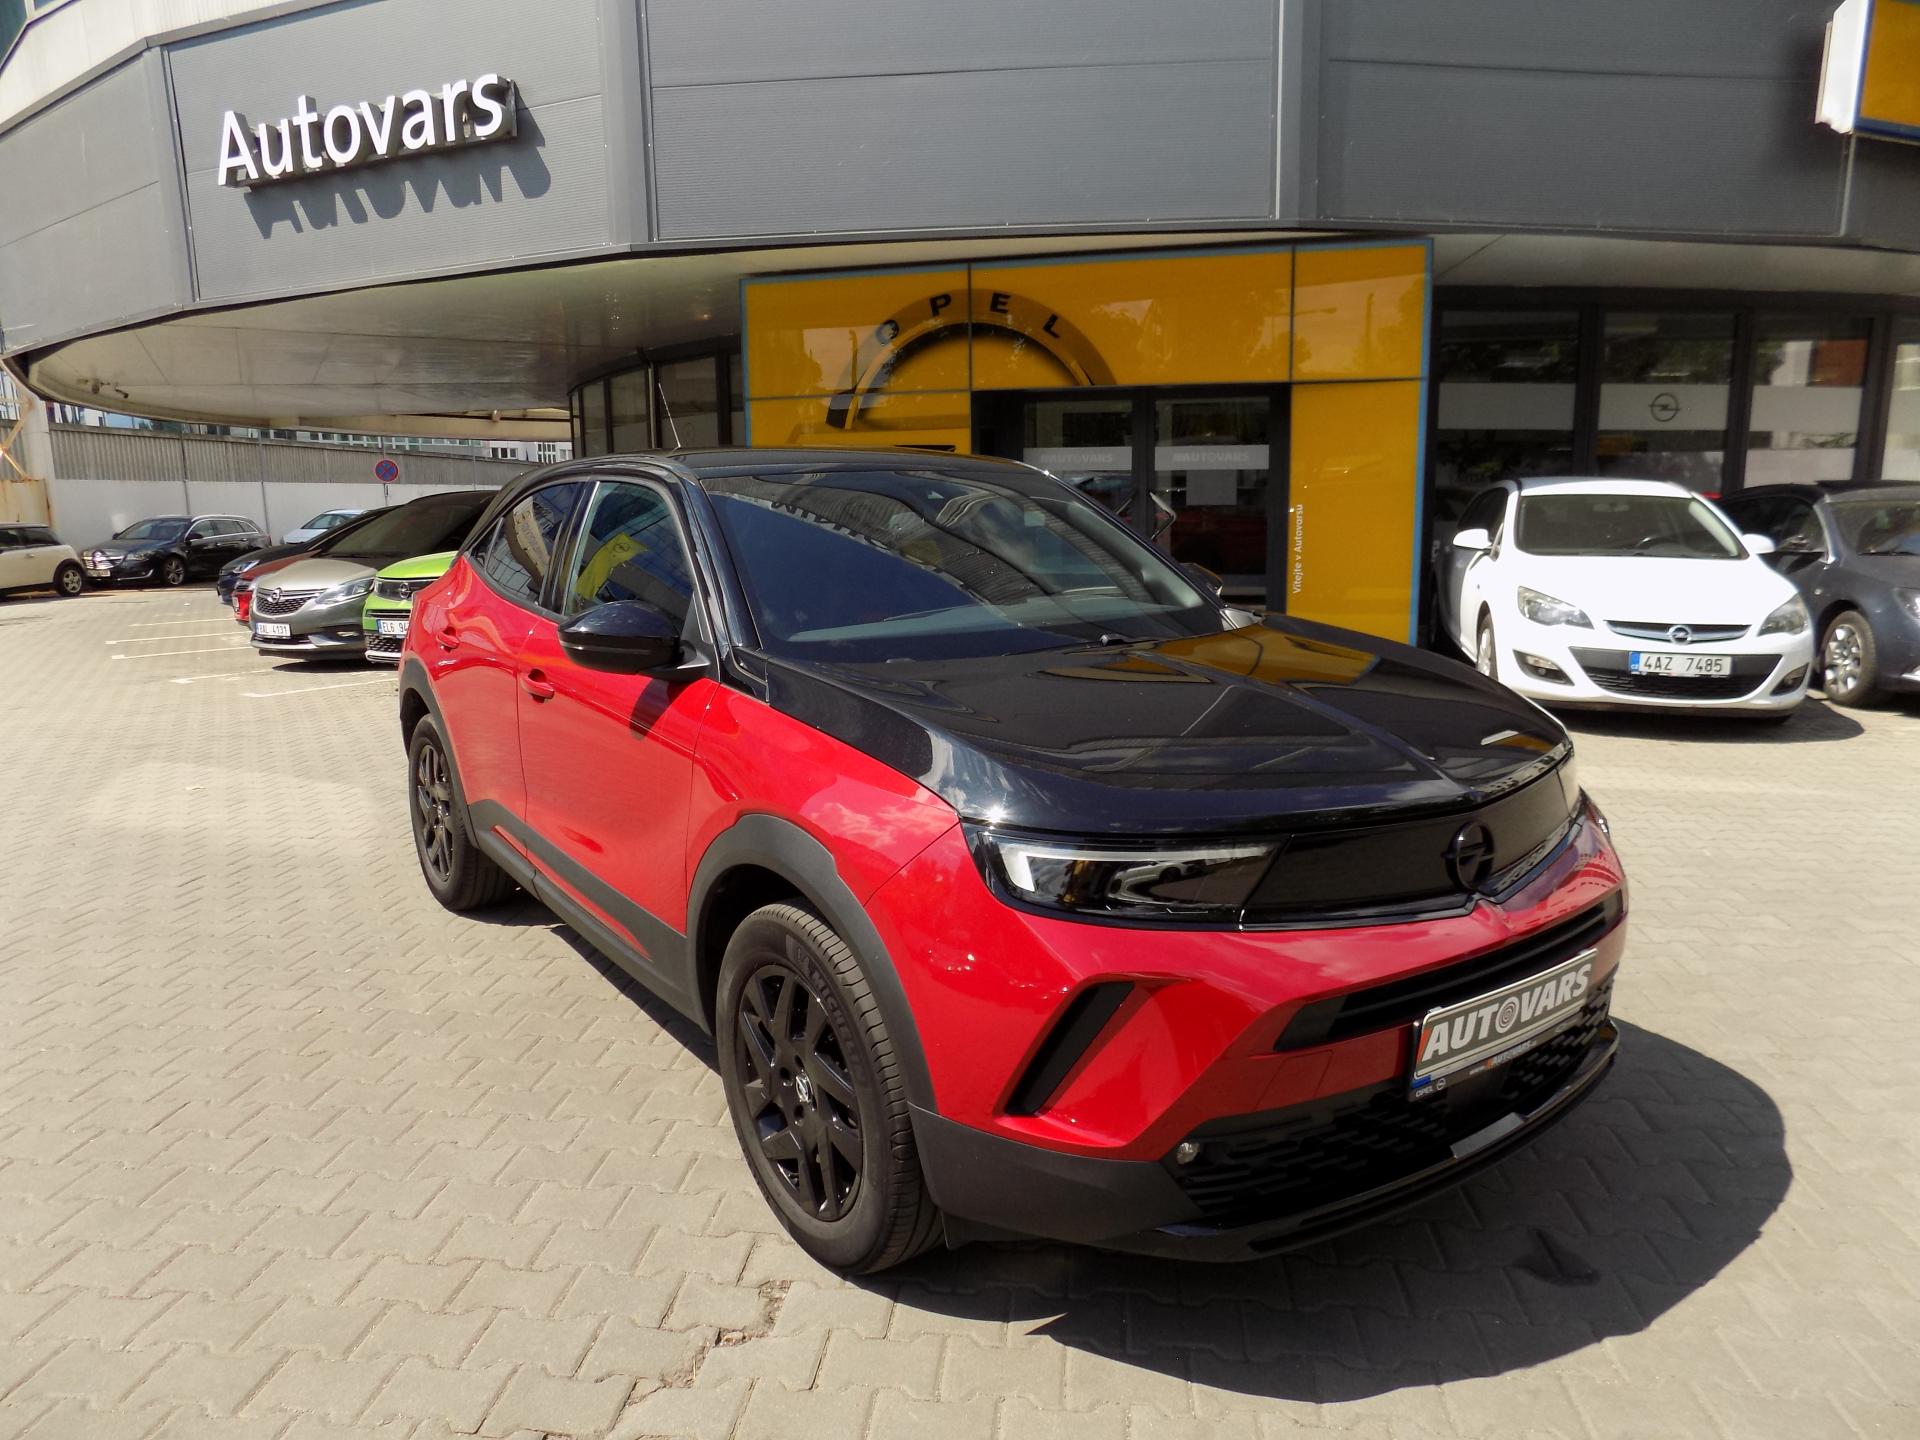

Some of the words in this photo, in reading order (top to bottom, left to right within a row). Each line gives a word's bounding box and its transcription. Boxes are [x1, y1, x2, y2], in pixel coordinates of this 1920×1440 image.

[217, 73, 504, 186] Autovars
[875, 292, 1061, 346] OPEL
[1644, 655, 1673, 671] 4AZ
[1685, 657, 1723, 673] 7485
[1421, 963, 1592, 1062] AUTOVARS
[1415, 1085, 1434, 1098] OPEL
